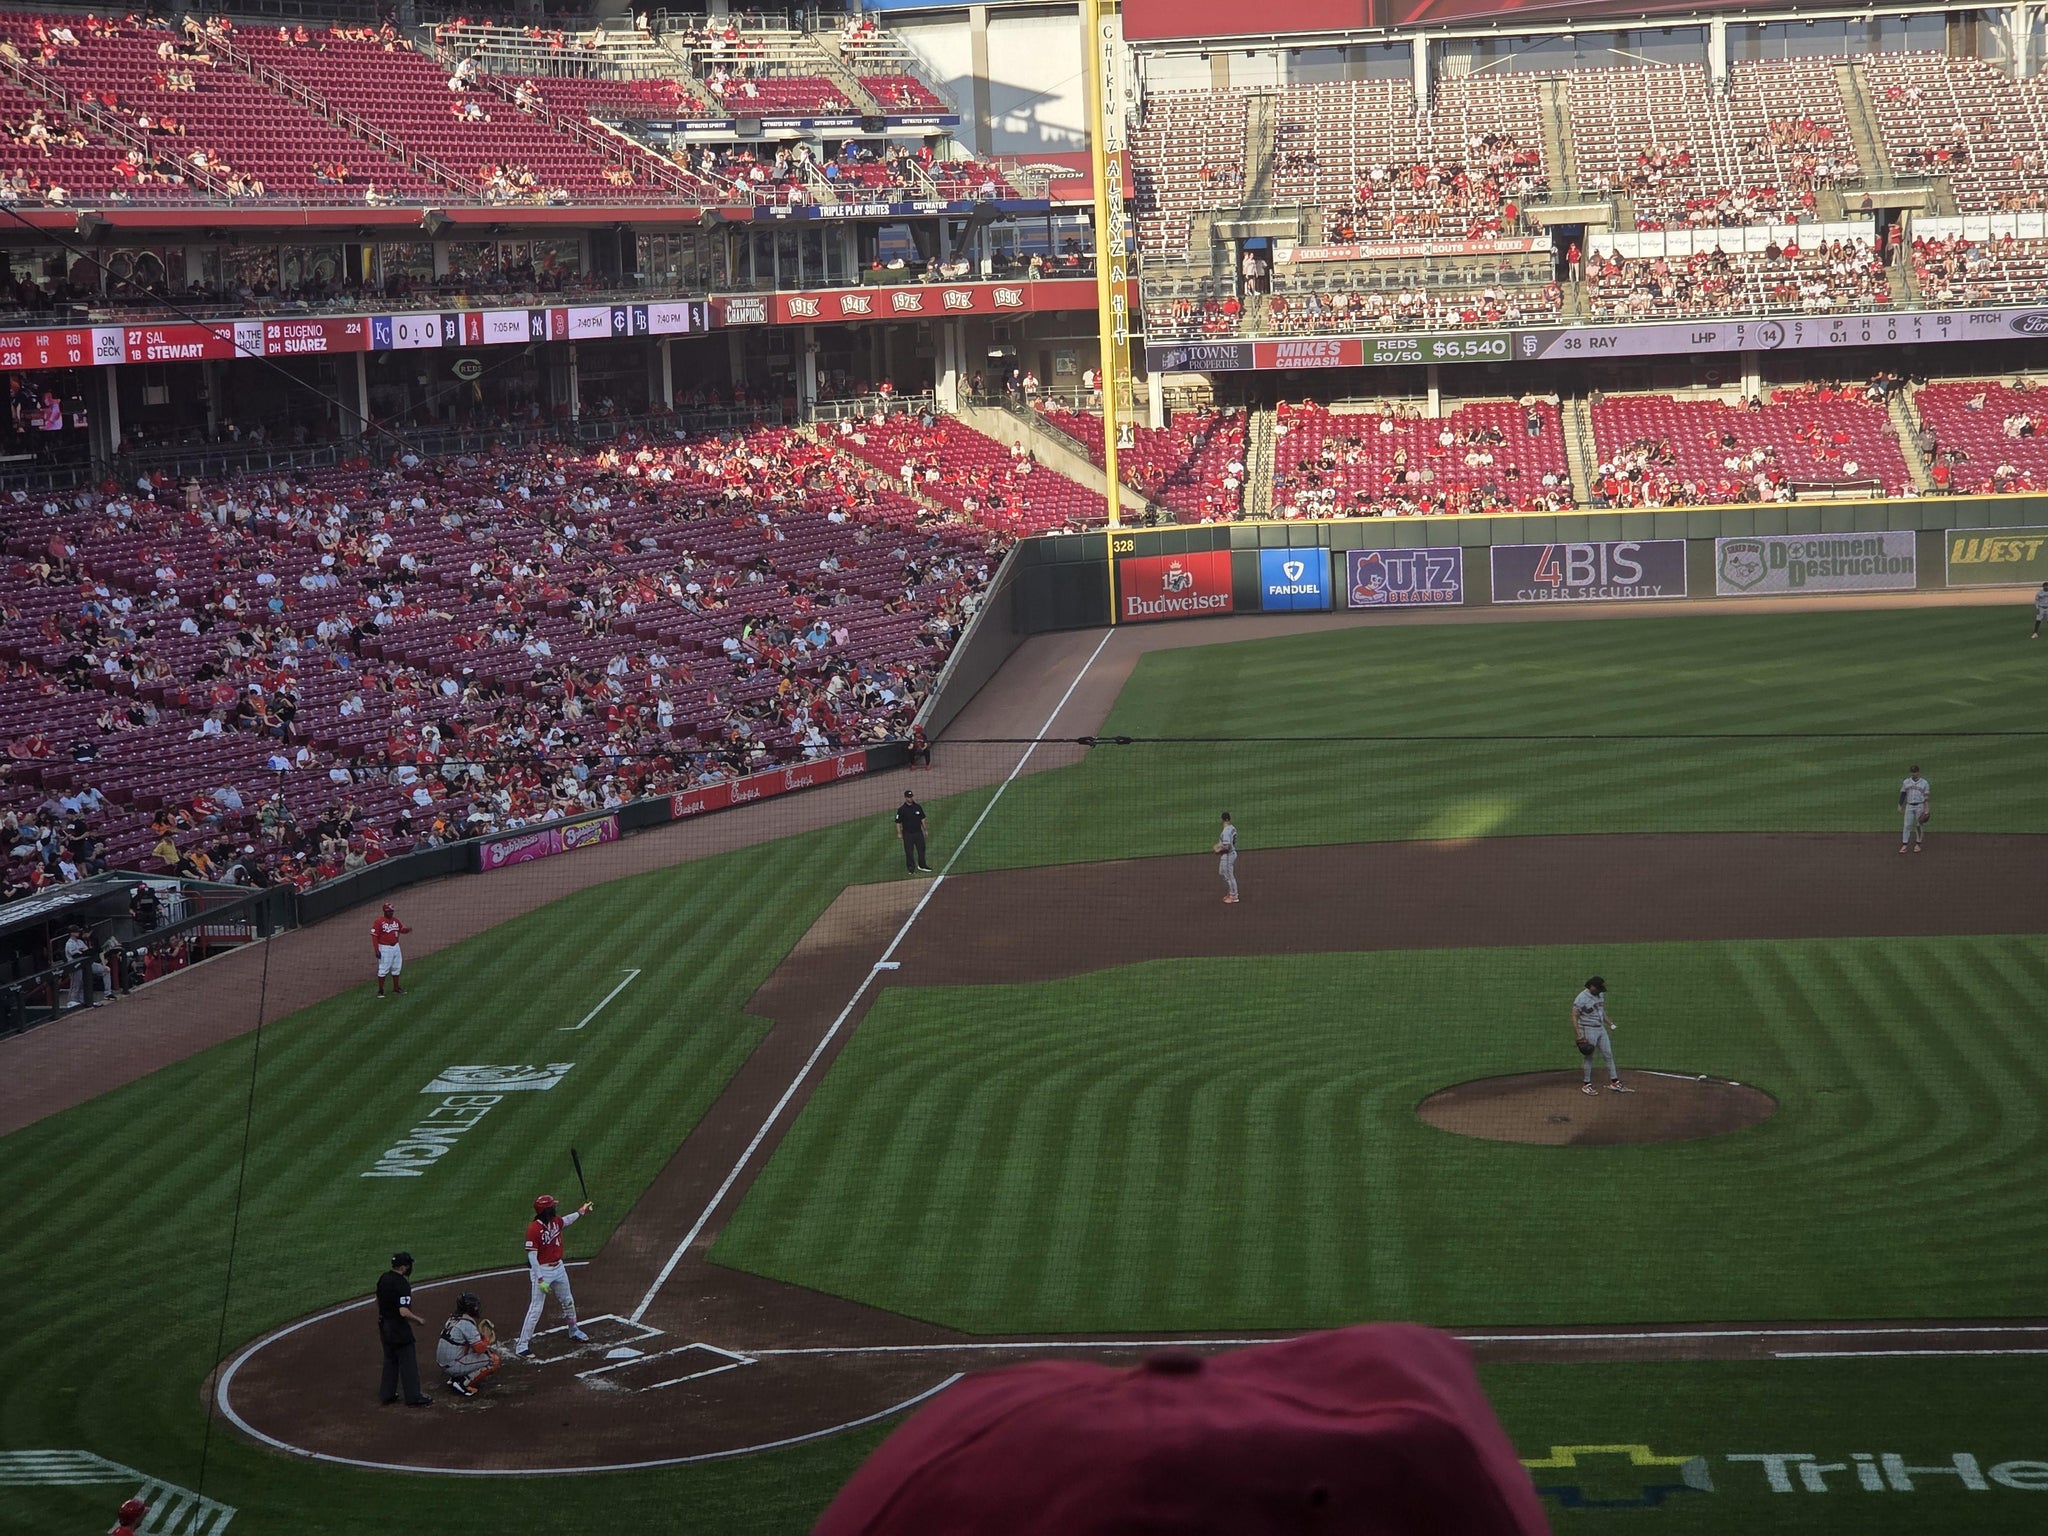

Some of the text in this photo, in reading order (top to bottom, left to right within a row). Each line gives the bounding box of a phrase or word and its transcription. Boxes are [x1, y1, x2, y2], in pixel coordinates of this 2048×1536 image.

[1103, 26, 1125, 345] CHIKIN IZ ALWAYZ A HIT
[819, 204, 889, 217] TRIPLE PLAY SUITES
[913, 202, 949, 210] CUTWATER
[1360, 246, 1400, 258] KROGER
[894, 296, 916, 309] 1975
[945, 294, 966, 307] 1976
[995, 290, 1016, 304] 1990
[790, 299, 814, 314] 1919
[842, 297, 865, 312] 1940
[657, 314, 670, 324] 7:40
[670, 314, 680, 322] PM
[726, 304, 764, 322] CHAMPIONS
[1970, 313, 2001, 324] PITCH
[494, 322, 508, 332] 7:05
[508, 322, 520, 332] PM
[578, 318, 591, 328] 7:40
[592, 318, 602, 327] PM
[1834, 320, 1844, 330] IP
[1862, 320, 1870, 328] H
[1888, 318, 1896, 328] R
[1914, 318, 1922, 326] K
[1937, 316, 1951, 326] BB
[268, 324, 323, 339] 28 EUGENIO
[345, 323, 361, 334] .224
[400, 324, 408, 340] 0
[426, 322, 434, 338] 0
[1737, 325, 1744, 334] B
[1794, 323, 1803, 332] S
[1915, 329, 1921, 338] 1
[1941, 328, 1947, 338] 1
[36, 336, 50, 346] HR
[66, 334, 81, 345] RBI
[102, 336, 115, 346] ON
[128, 332, 166, 345] 27 SAL
[237, 330, 262, 340] IN THE
[1564, 338, 1582, 350] 38
[1590, 336, 1618, 348] RAY
[1692, 332, 1716, 344] LHP
[1762, 330, 1776, 342] 14
[1795, 334, 1803, 344] 7
[1830, 332, 1848, 343] 0.1
[1862, 331, 1870, 342] 0
[1888, 330, 1896, 340] 0
[0, 336, 21, 348] AVG
[240, 340, 260, 350] HOLE
[269, 336, 328, 354] DH SUÁREZ
[1377, 340, 1418, 350] REDS
[1737, 336, 1744, 347] 7
[97, 347, 121, 357] DECK
[132, 344, 204, 360] 1B STEWART
[1188, 346, 1239, 360] TOWNE
[1276, 340, 1341, 358] MIKE'S
[1432, 340, 1506, 358] $6,540
[1, 352, 22, 366] .281
[40, 352, 48, 364] 5
[68, 350, 81, 362] 10
[1373, 352, 1422, 362] 50/50
[1189, 360, 1239, 370] PROPERTIES
[1113, 540, 1134, 552] 328
[1950, 538, 2044, 564] WEST
[1770, 537, 1886, 570] Document
[1534, 542, 1643, 588] 4BIS
[1788, 556, 1915, 587] Destruction
[1269, 584, 1320, 596] FANDUEL
[1517, 585, 1662, 601] CYBER SECURITY
[1389, 591, 1454, 602] BRANDS
[1127, 592, 1229, 616] Budweiser
